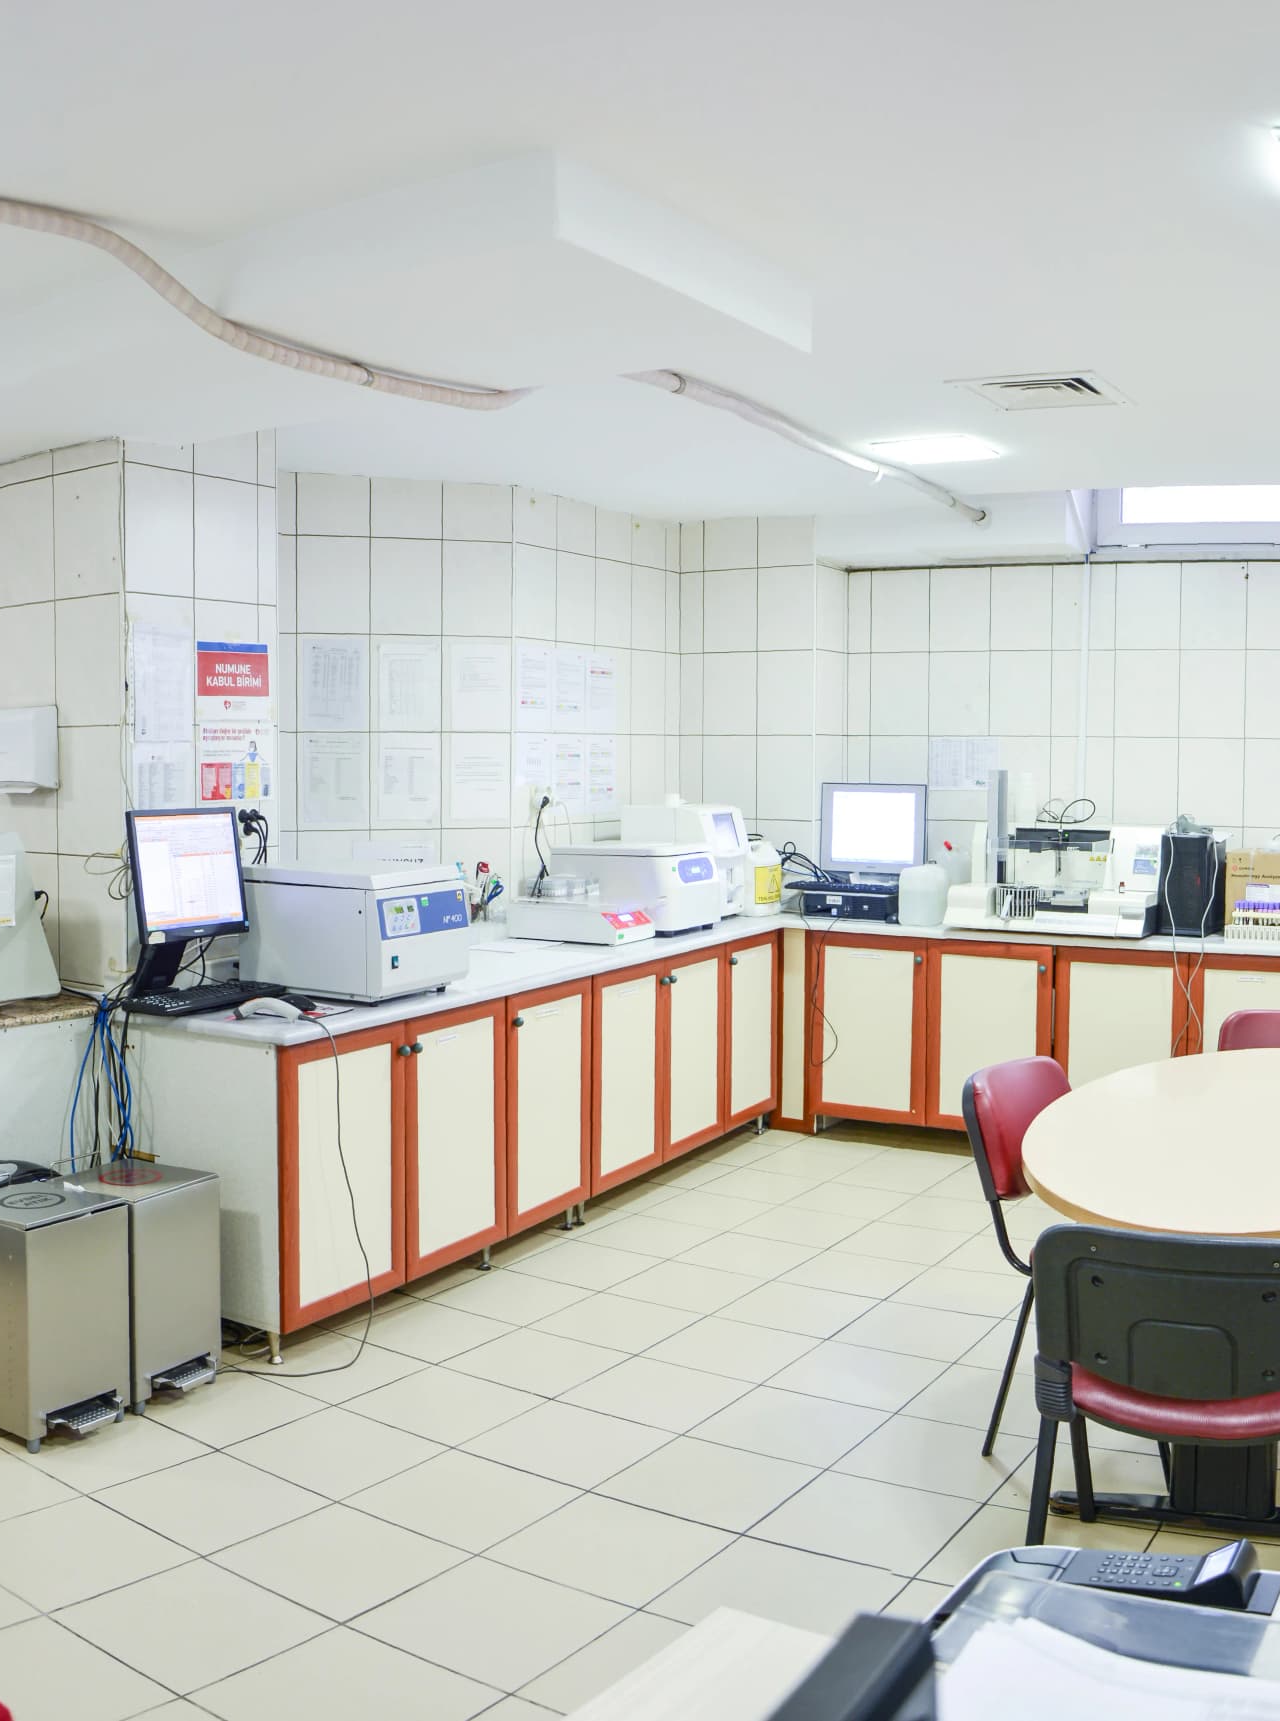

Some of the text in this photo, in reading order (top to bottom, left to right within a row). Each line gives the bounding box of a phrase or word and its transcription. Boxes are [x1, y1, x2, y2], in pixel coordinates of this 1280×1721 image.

[215, 663, 251, 674] NUMUNE
[206, 675, 262, 688] KABUL BİRİMİ
